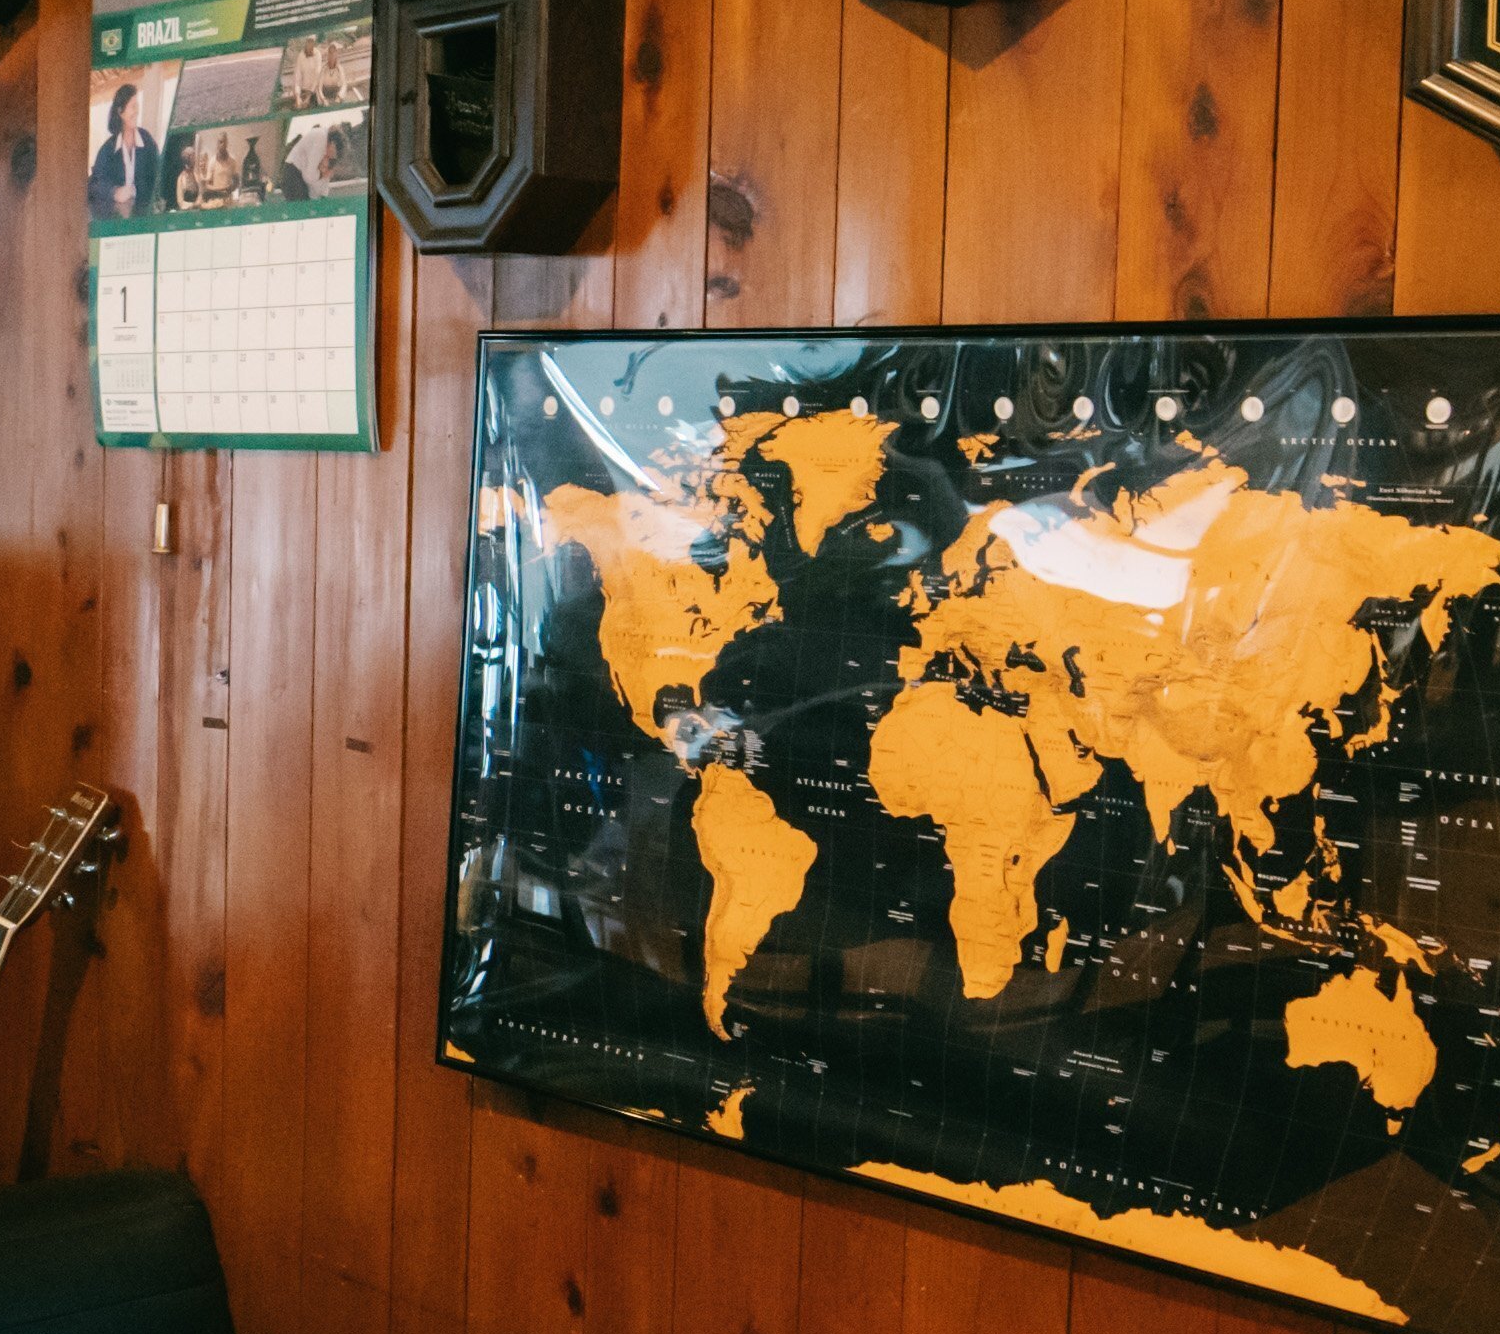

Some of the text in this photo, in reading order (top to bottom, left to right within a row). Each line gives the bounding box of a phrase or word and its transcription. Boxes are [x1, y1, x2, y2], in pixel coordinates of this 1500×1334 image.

[137, 17, 183, 48] BRAZIL
[119, 286, 127, 323] 1
[1280, 438, 1398, 447] ARCTIC OCEAN
[554, 769, 623, 786] PACIFIC
[796, 777, 853, 792] ATLANTIC
[564, 803, 617, 818] OCEAN
[808, 805, 846, 817] OCEAN
[1104, 924, 1205, 949] INDIAN
[1112, 969, 1197, 992] OCEAN
[498, 1018, 644, 1060] SOUTHERN OCEAN
[1044, 1158, 1258, 1220] SOUTHERN OCEAN
